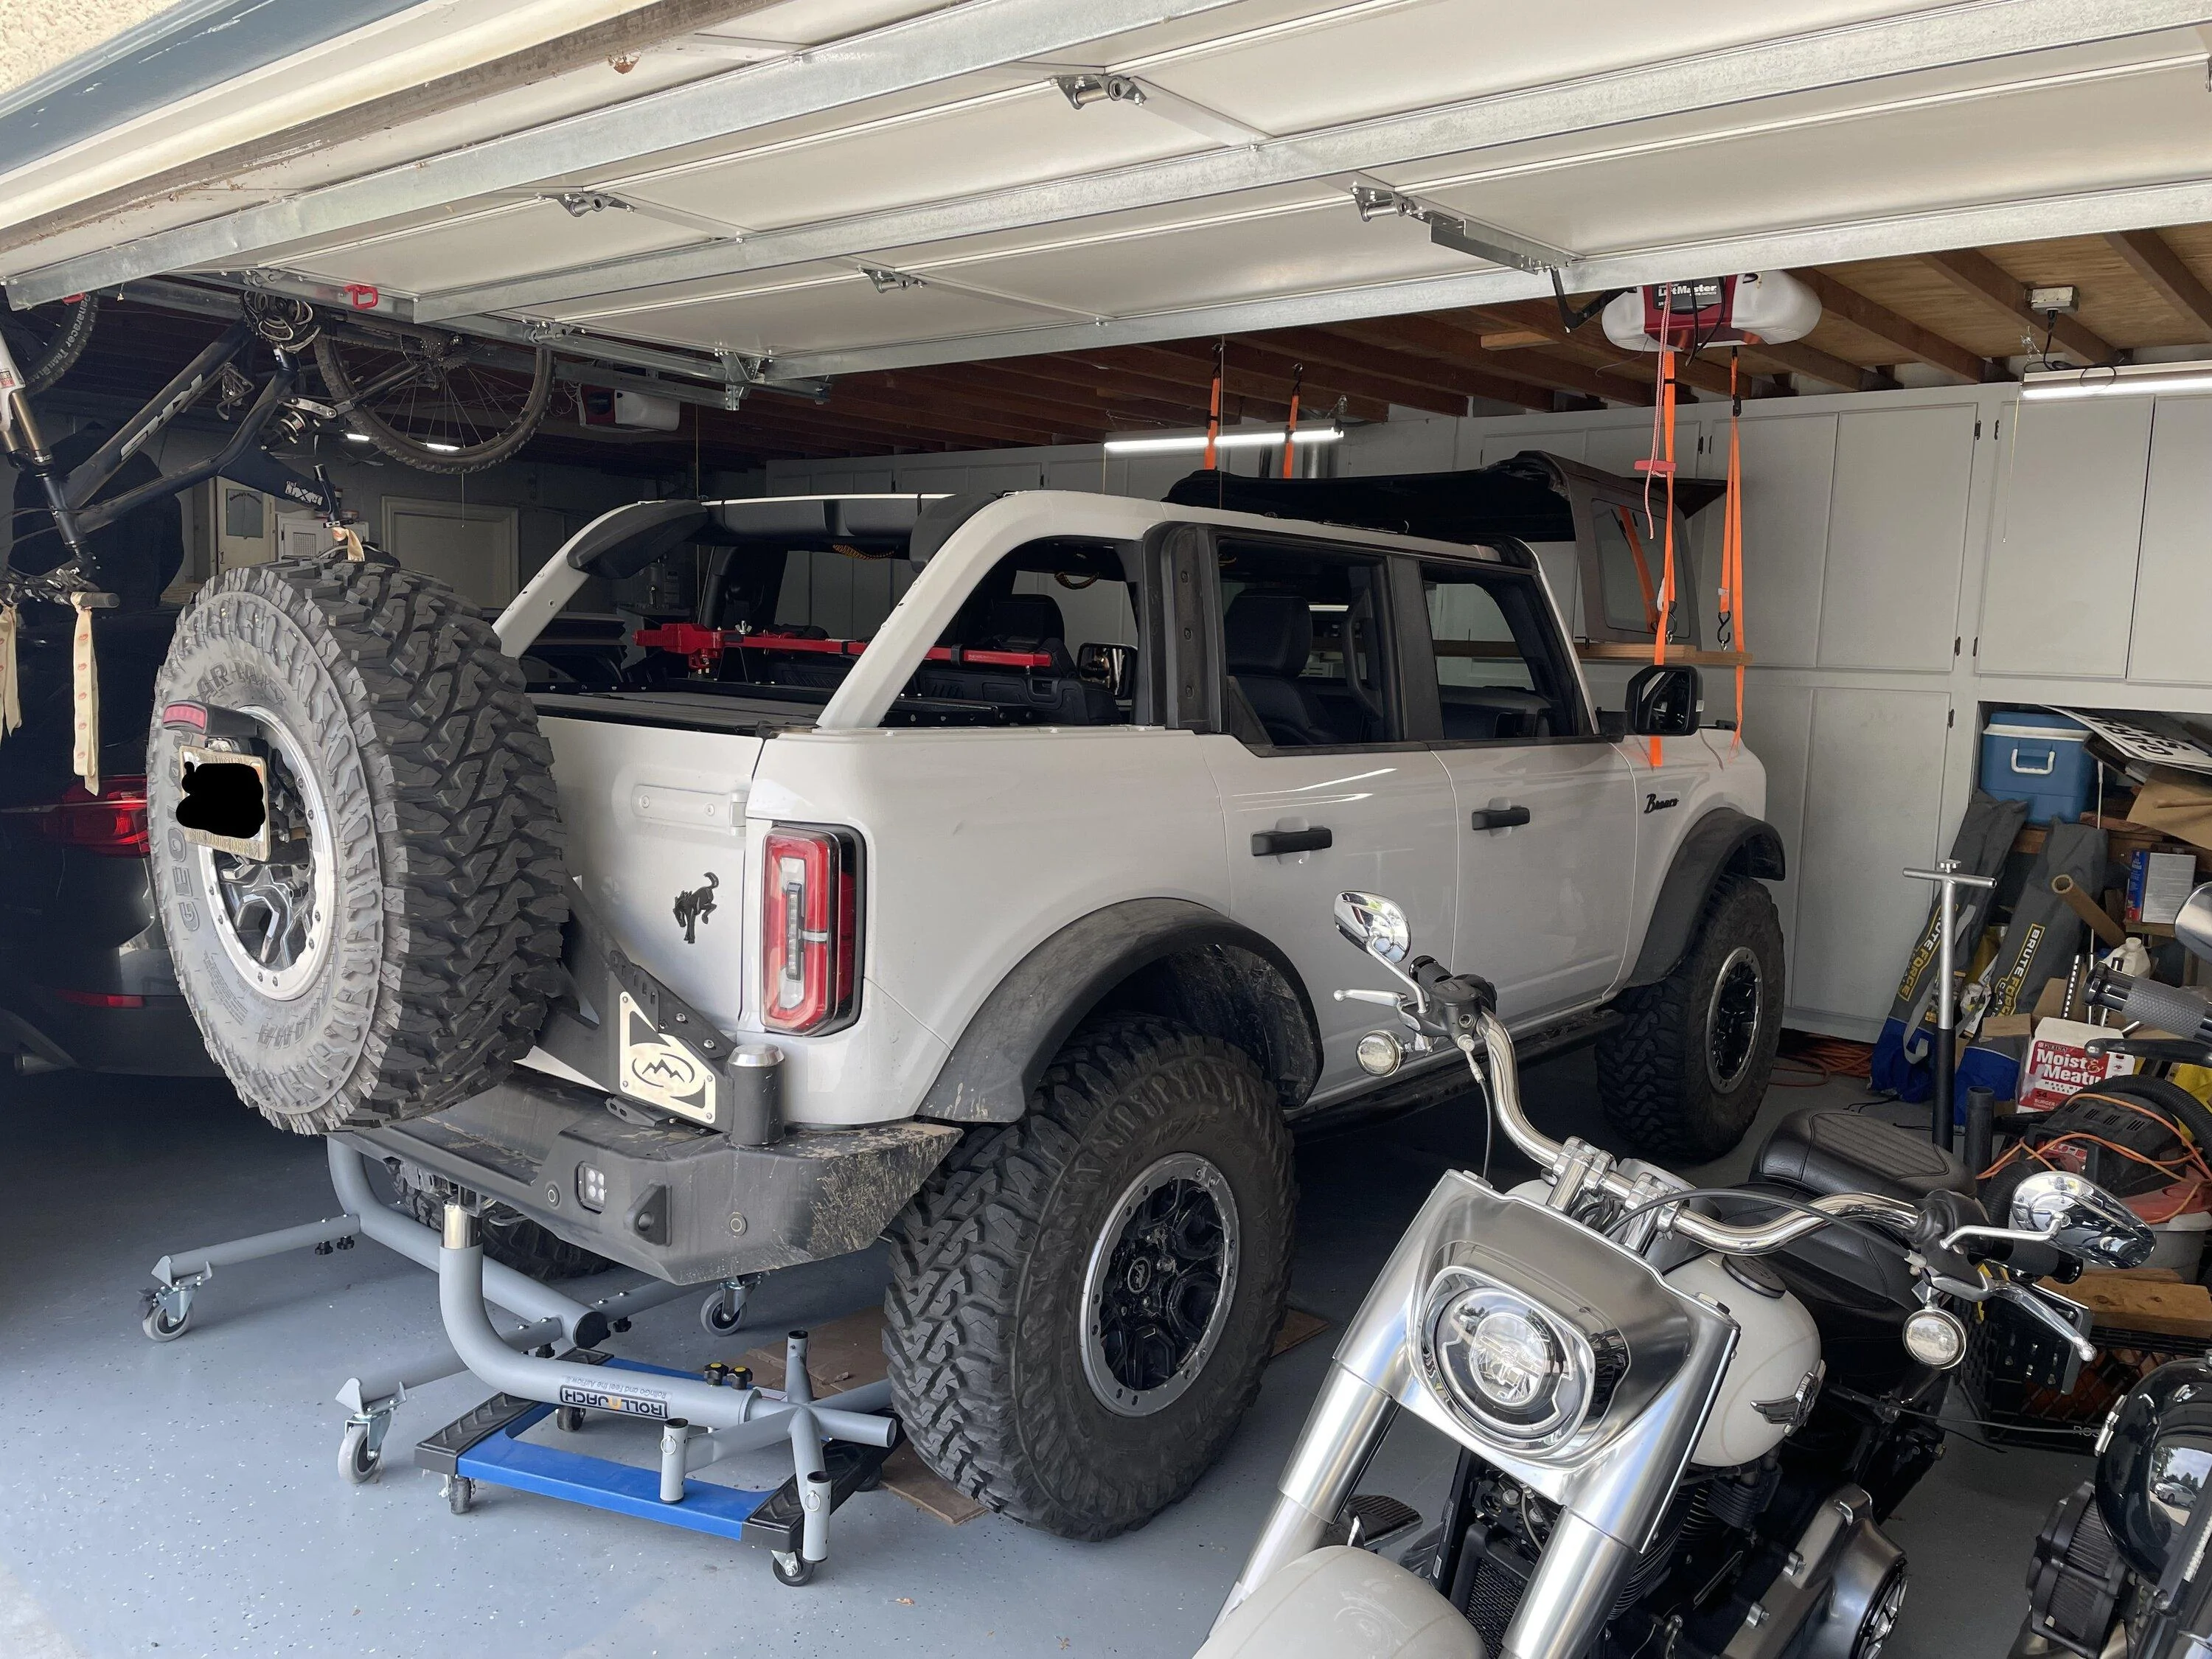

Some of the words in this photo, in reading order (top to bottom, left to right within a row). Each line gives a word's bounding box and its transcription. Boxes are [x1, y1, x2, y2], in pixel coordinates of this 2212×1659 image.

[1658, 285, 1717, 296] LitMaster
[2014, 928, 2040, 977] BRUTE
[1902, 948, 1929, 996] FORCE
[1997, 977, 2020, 1016] FORC
[2044, 1043, 2067, 1052] PURINA
[2036, 1048, 2087, 1069] Moist
[2034, 1098, 2056, 1107] BURGER
[597, 1380, 608, 1388] the
[608, 1382, 623, 1392] Feel
[625, 1385, 638, 1394] and
